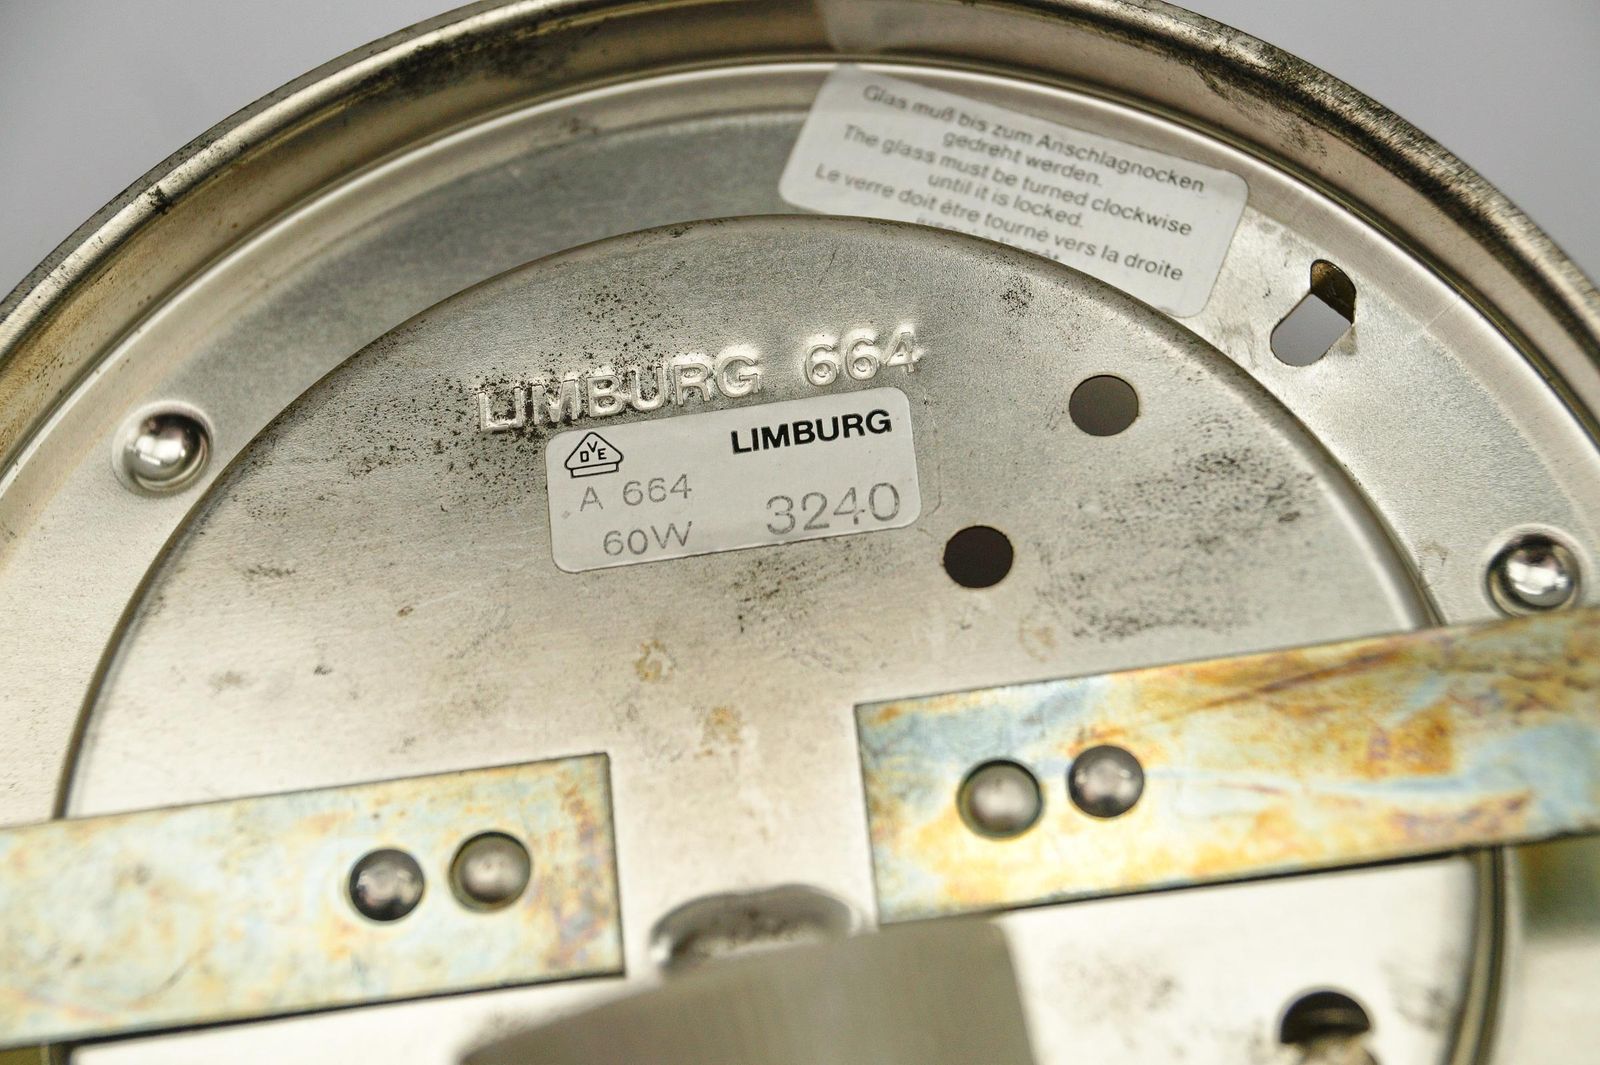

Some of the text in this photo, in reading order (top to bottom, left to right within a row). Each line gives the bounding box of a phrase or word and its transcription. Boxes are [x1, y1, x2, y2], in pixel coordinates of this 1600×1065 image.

[863, 84, 1205, 193] Glas muß bis zum Anschlagnocken
[943, 131, 1102, 187] gedreht werden.
[843, 124, 1192, 236] The glass must be turned clockwise
[927, 173, 1083, 228] until it is locked.
[815, 163, 840, 182] Le
[845, 176, 895, 198] verre
[898, 188, 937, 211] doit
[985, 210, 1049, 243] tourné
[1054, 235, 1096, 257] vers
[1101, 246, 1119, 263] la
[1124, 252, 1184, 281] droite
[478, 331, 917, 432] LIMBURG 664
[731, 409, 893, 455] LIMBURG
[579, 473, 693, 512] A 664
[766, 481, 901, 535] 3240
[603, 519, 694, 556] 60W
